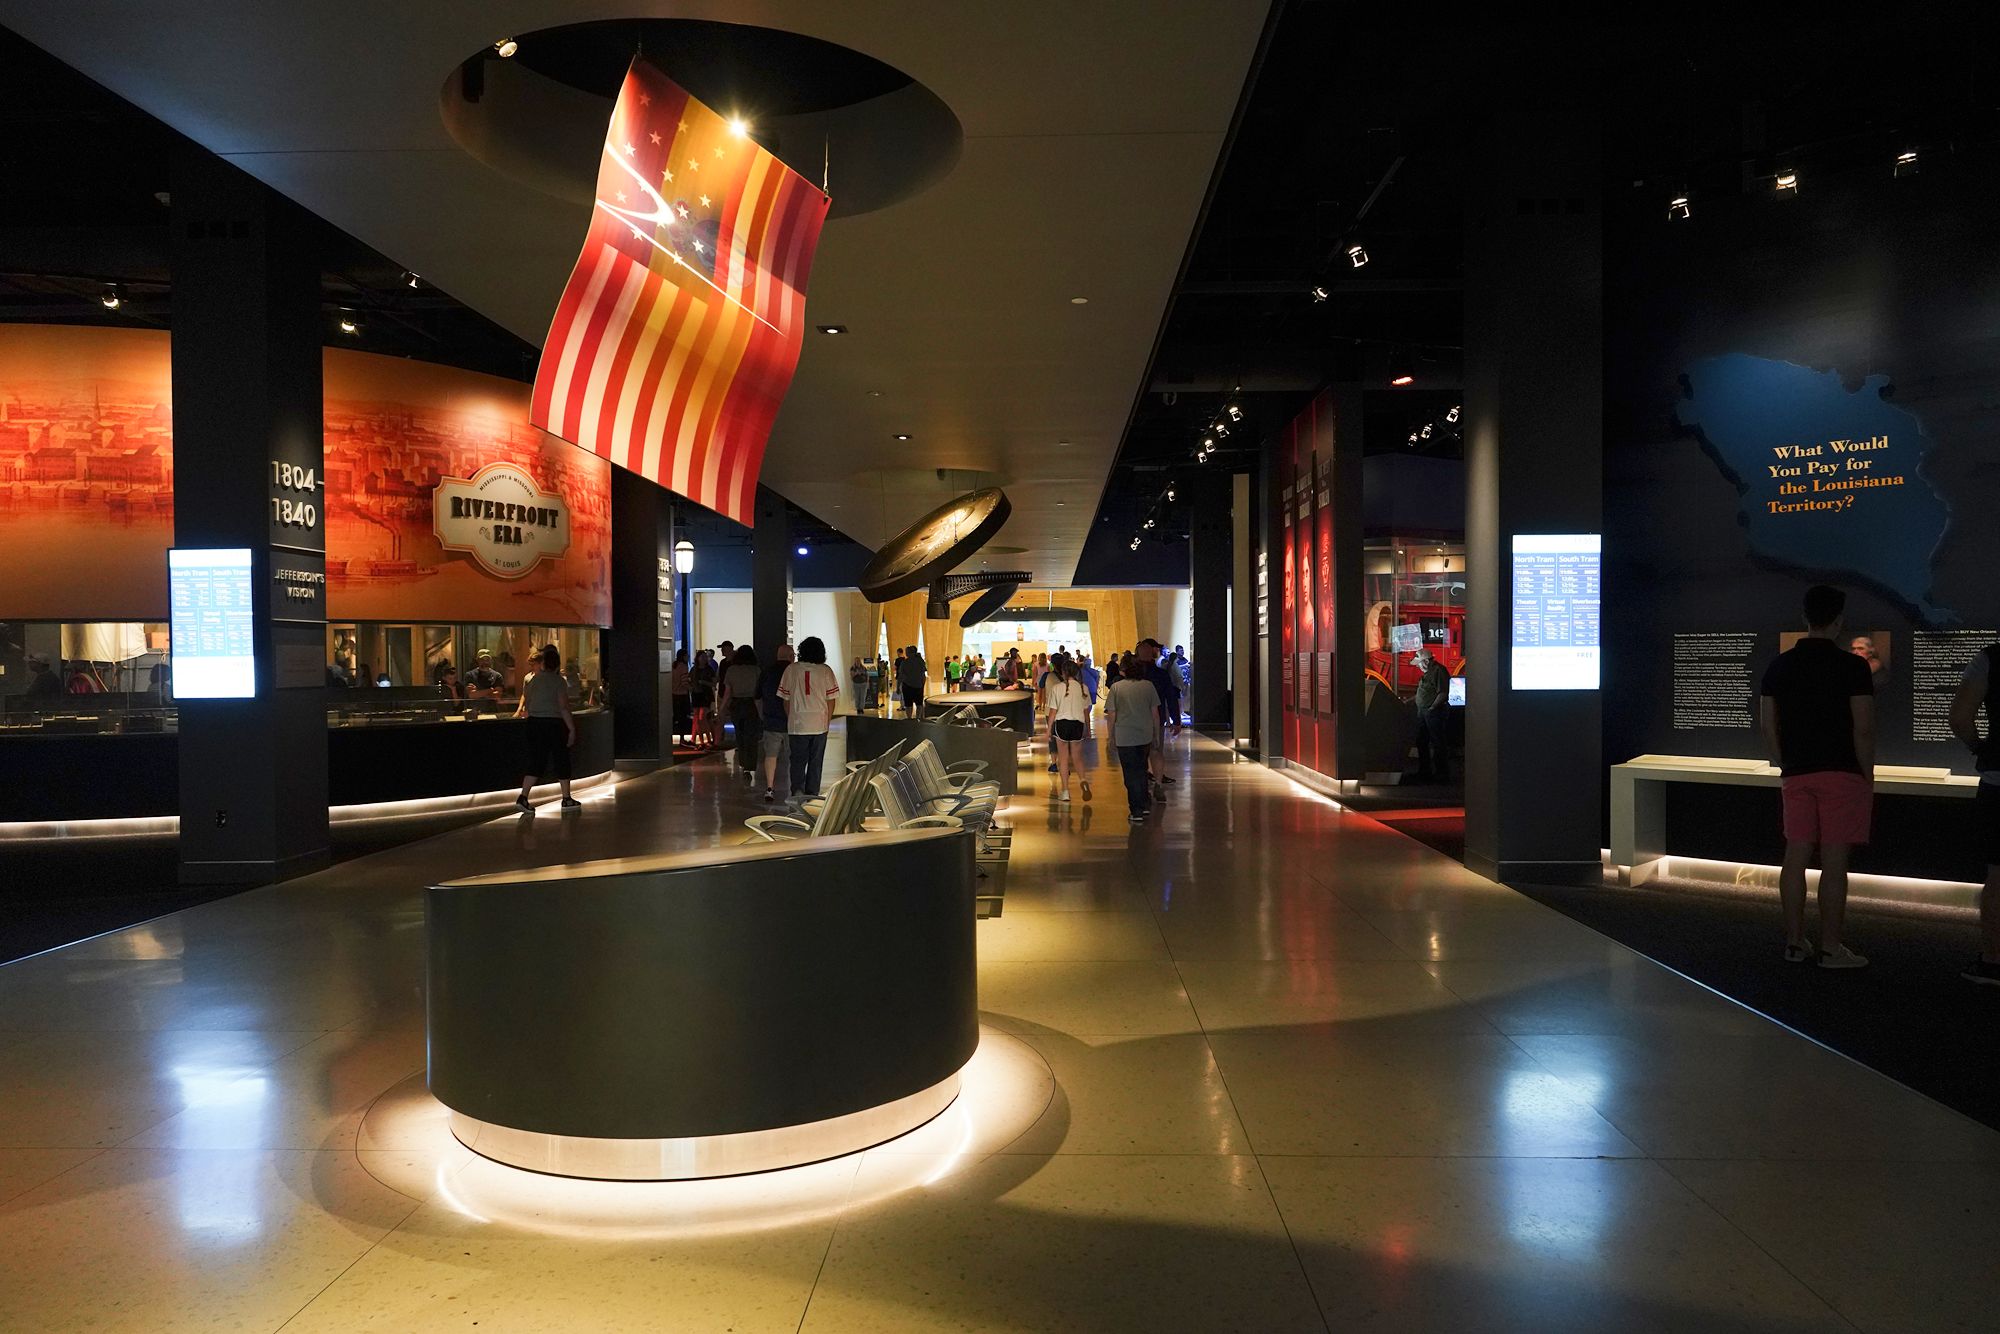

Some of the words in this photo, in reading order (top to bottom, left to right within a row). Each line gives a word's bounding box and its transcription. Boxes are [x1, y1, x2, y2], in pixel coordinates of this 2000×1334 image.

[1773, 444, 1823, 460] What
[1829, 436, 1889, 454] Would
[1768, 465, 1801, 478] You
[1807, 461, 1840, 476] Pay
[1846, 458, 1872, 471] for
[479, 474, 507, 491] MISSISSIPPI
[513, 477, 534, 498] MISSOURI
[1779, 482, 1807, 495] the
[1813, 475, 1904, 492] Louisiana
[271, 498, 316, 528] 1840
[451, 496, 559, 529] RIVERFRONT
[1767, 495, 1855, 514] Territory?
[493, 525, 523, 545] ERA
[502, 560, 521, 568] LOUIS
[274, 568, 325, 584] JEFFERSON'S
[287, 586, 316, 599] VISION
